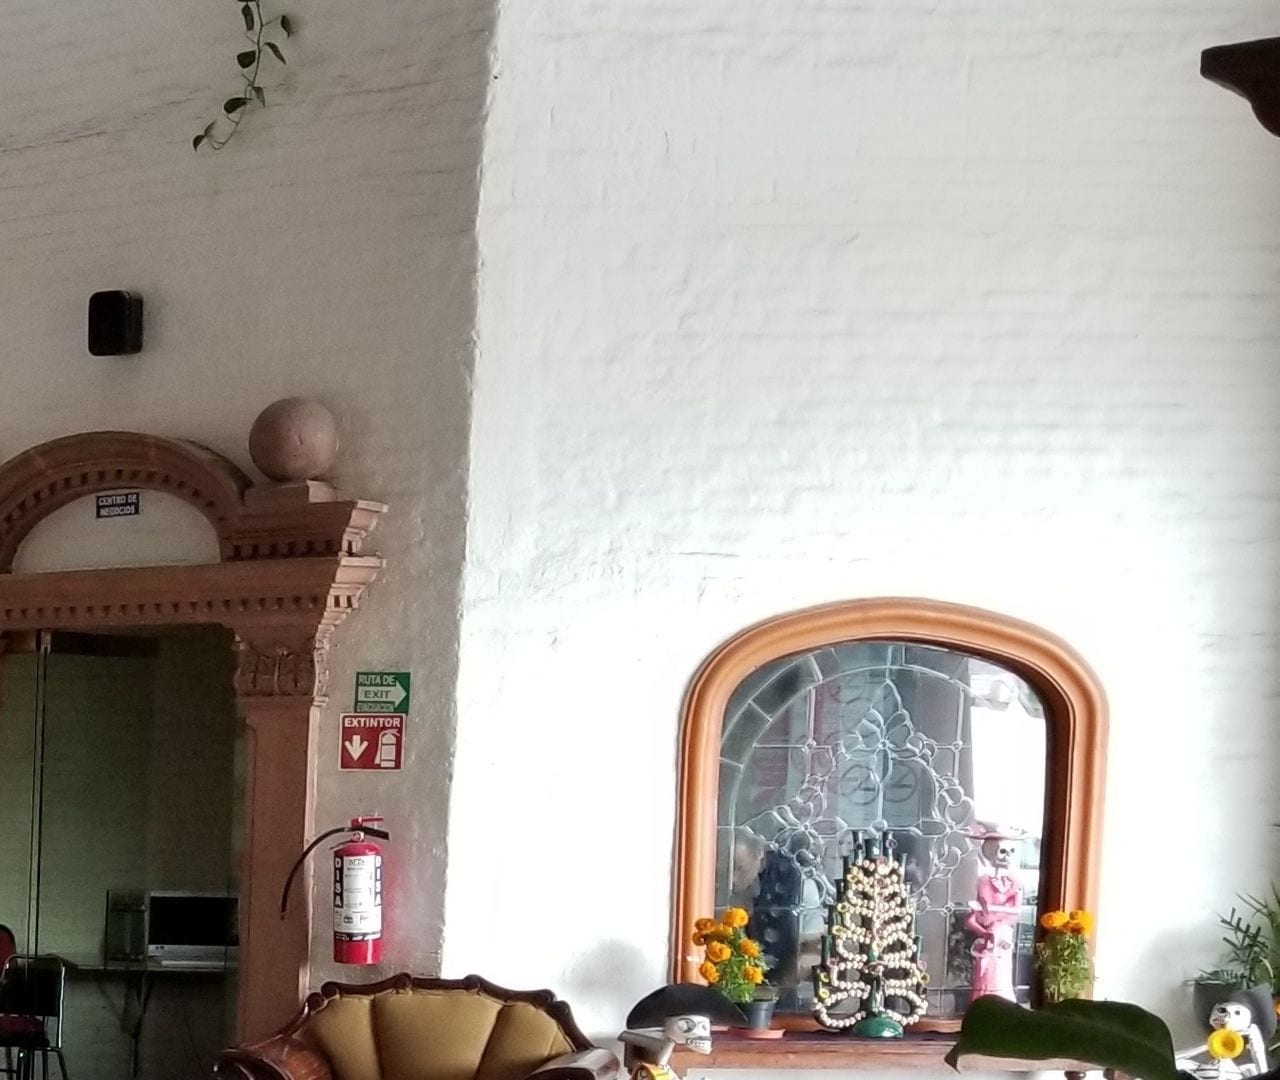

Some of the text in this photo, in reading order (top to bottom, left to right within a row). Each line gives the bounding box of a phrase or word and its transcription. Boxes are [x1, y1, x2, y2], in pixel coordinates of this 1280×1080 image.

[358, 674, 396, 685] RUTA DE
[364, 690, 391, 699] EXIT
[344, 717, 401, 728] EXTINTOR
